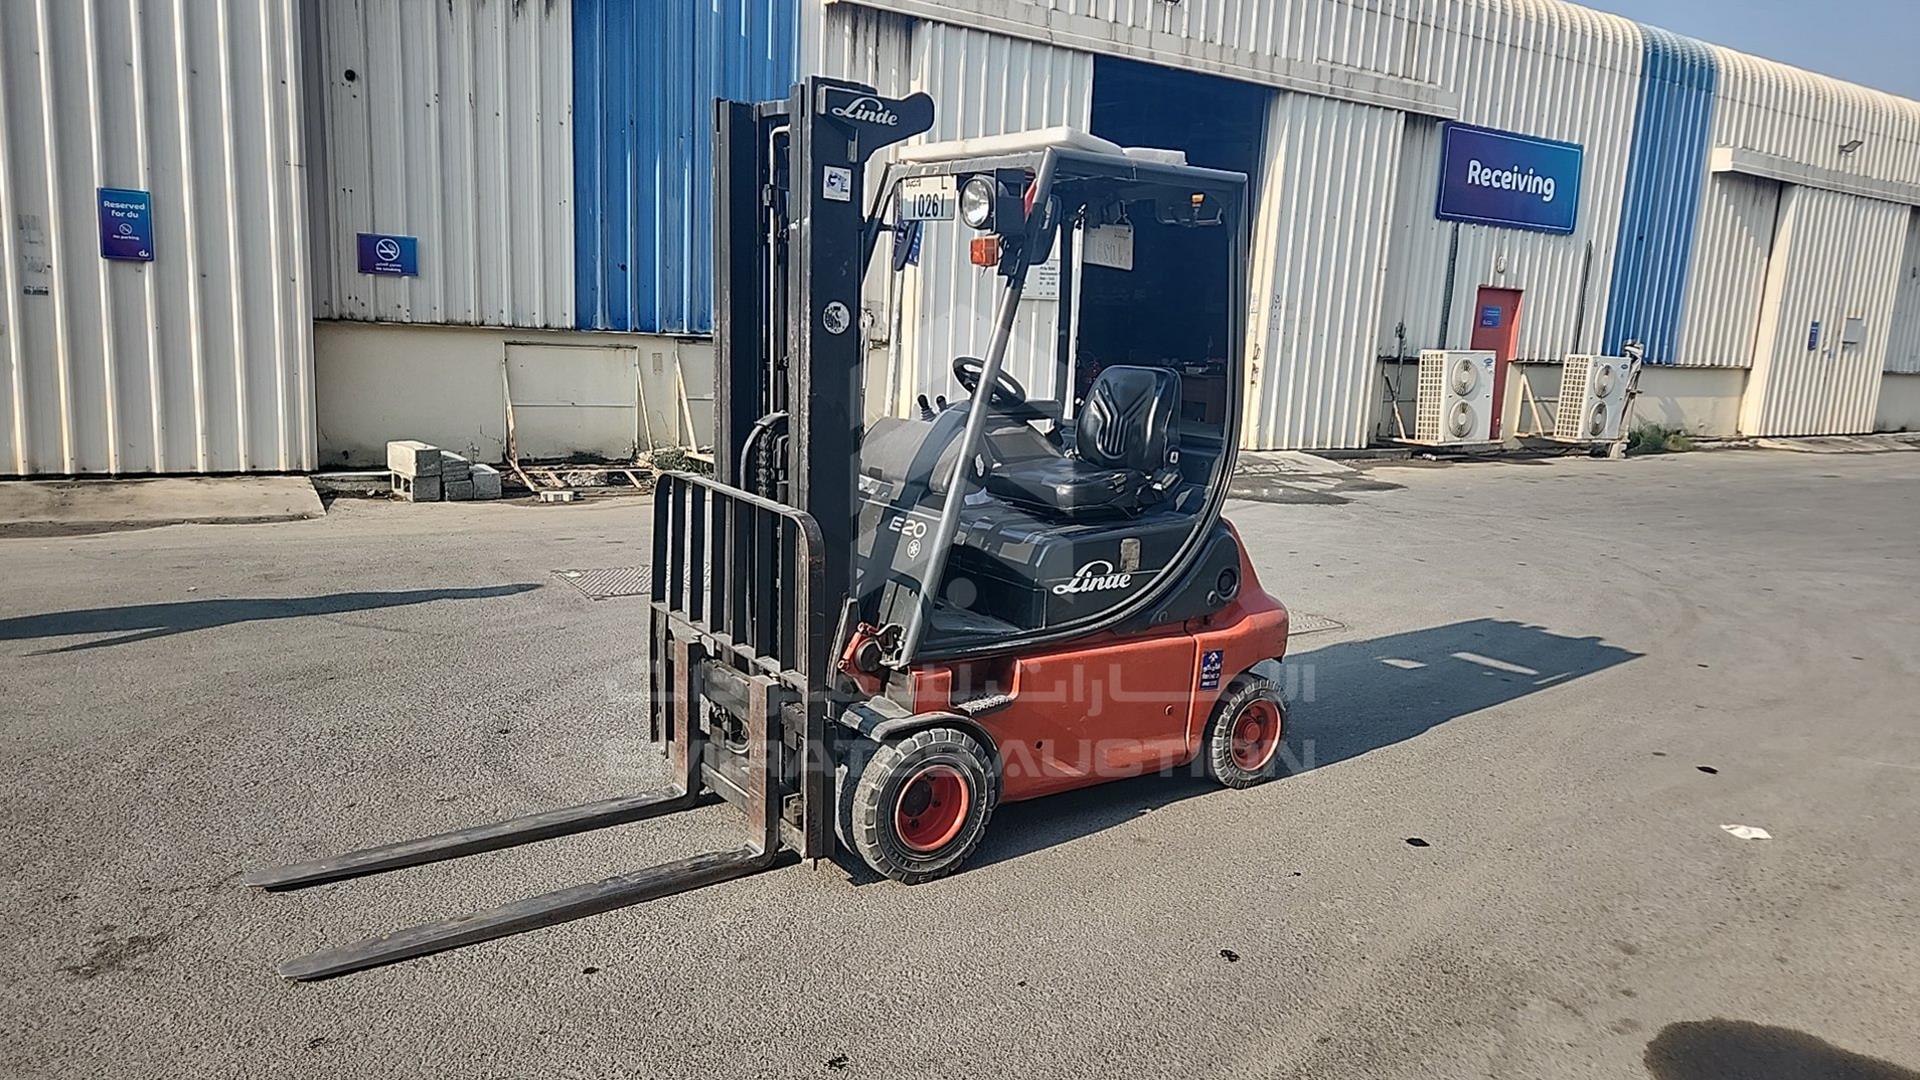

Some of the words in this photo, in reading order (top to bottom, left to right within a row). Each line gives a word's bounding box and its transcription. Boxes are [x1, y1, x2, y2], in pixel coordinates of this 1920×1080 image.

[831, 97, 898, 125] Linde
[1467, 159, 1556, 202] Receiving
[103, 200, 145, 210] Reserved
[111, 209, 125, 217] for
[126, 210, 139, 218] du
[912, 193, 945, 217] 10261
[138, 248, 149, 257] du
[889, 516, 927, 538] E20
[1052, 560, 1131, 594] Linde
